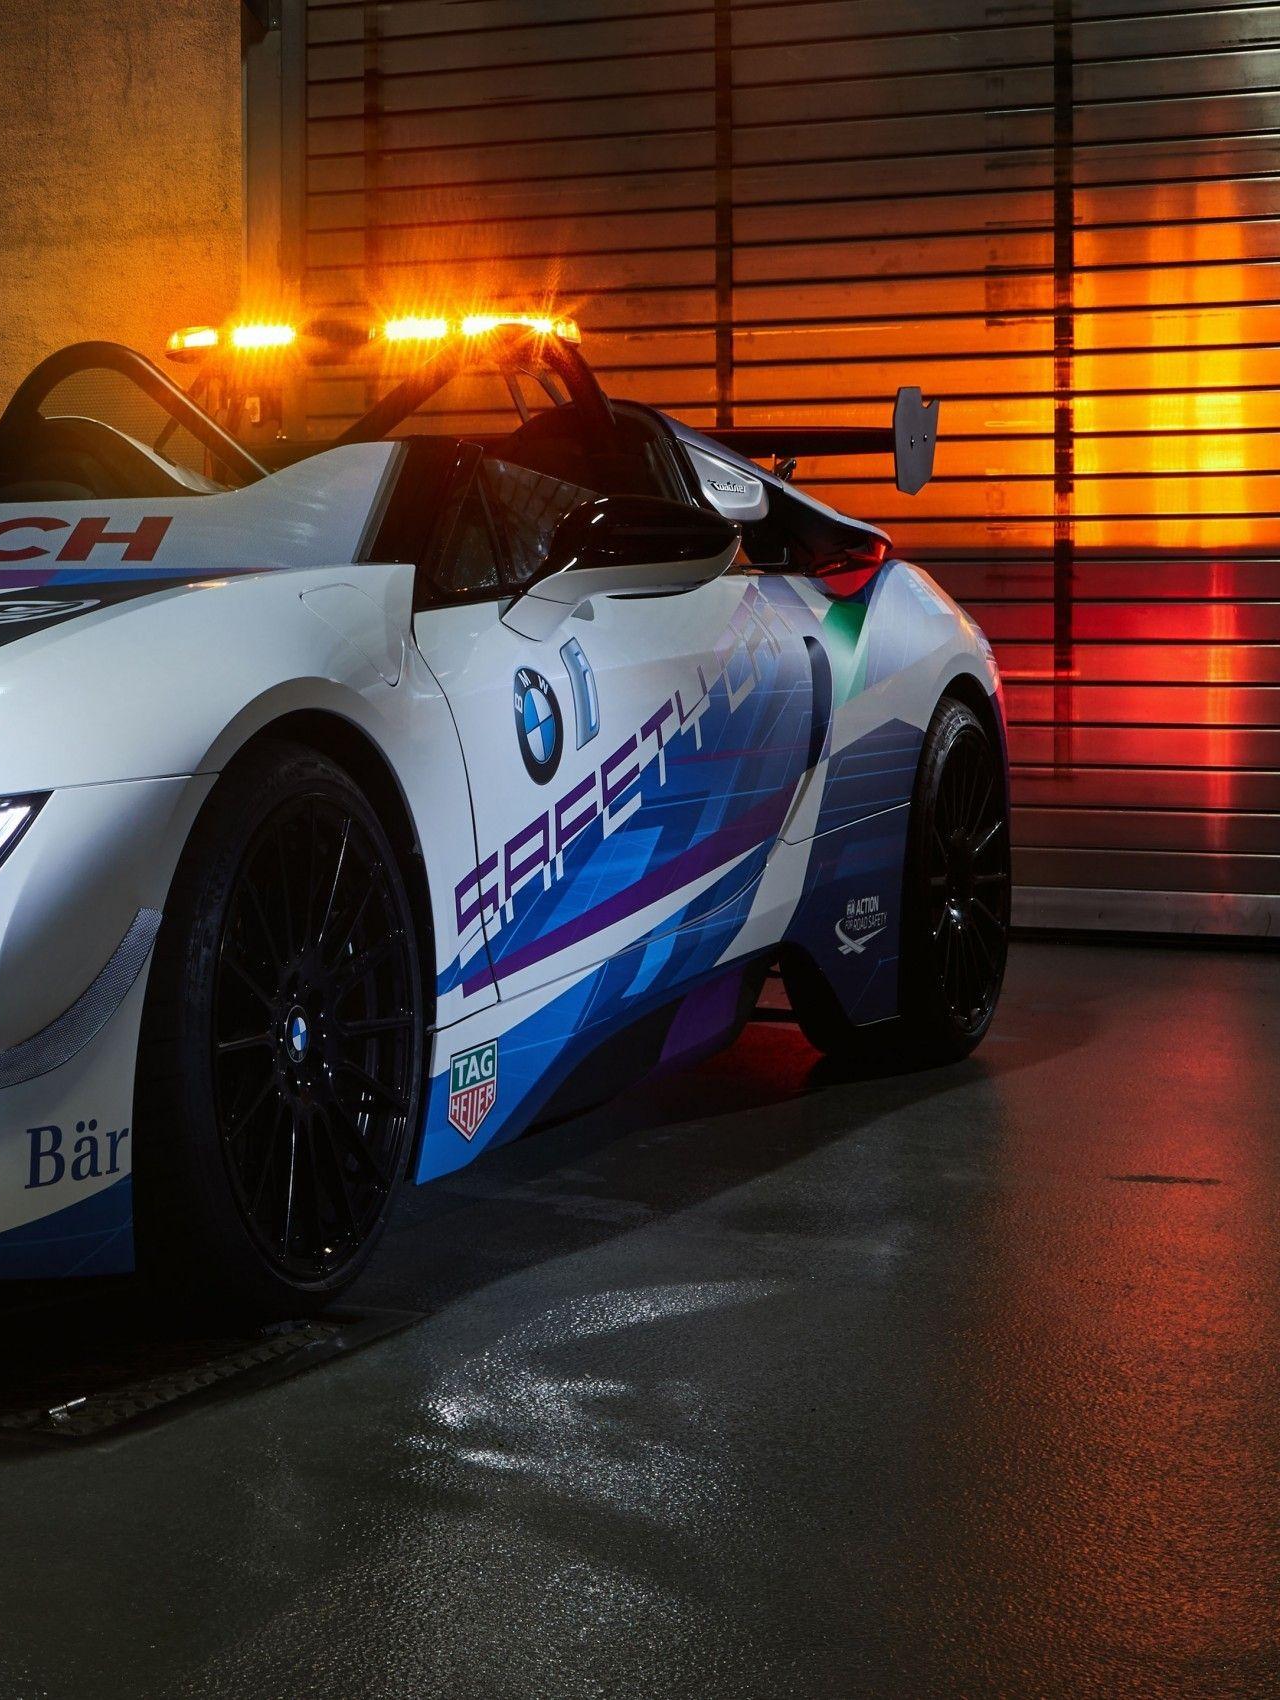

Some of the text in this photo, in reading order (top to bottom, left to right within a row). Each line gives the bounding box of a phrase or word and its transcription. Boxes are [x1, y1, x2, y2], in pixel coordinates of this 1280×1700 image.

[455, 664, 711, 969] SAFETY
[856, 896, 879, 915] ACTION
[454, 1049, 494, 1087] TAG
[451, 1083, 495, 1133] HEUER
[24, 1118, 129, 1190] Bär
